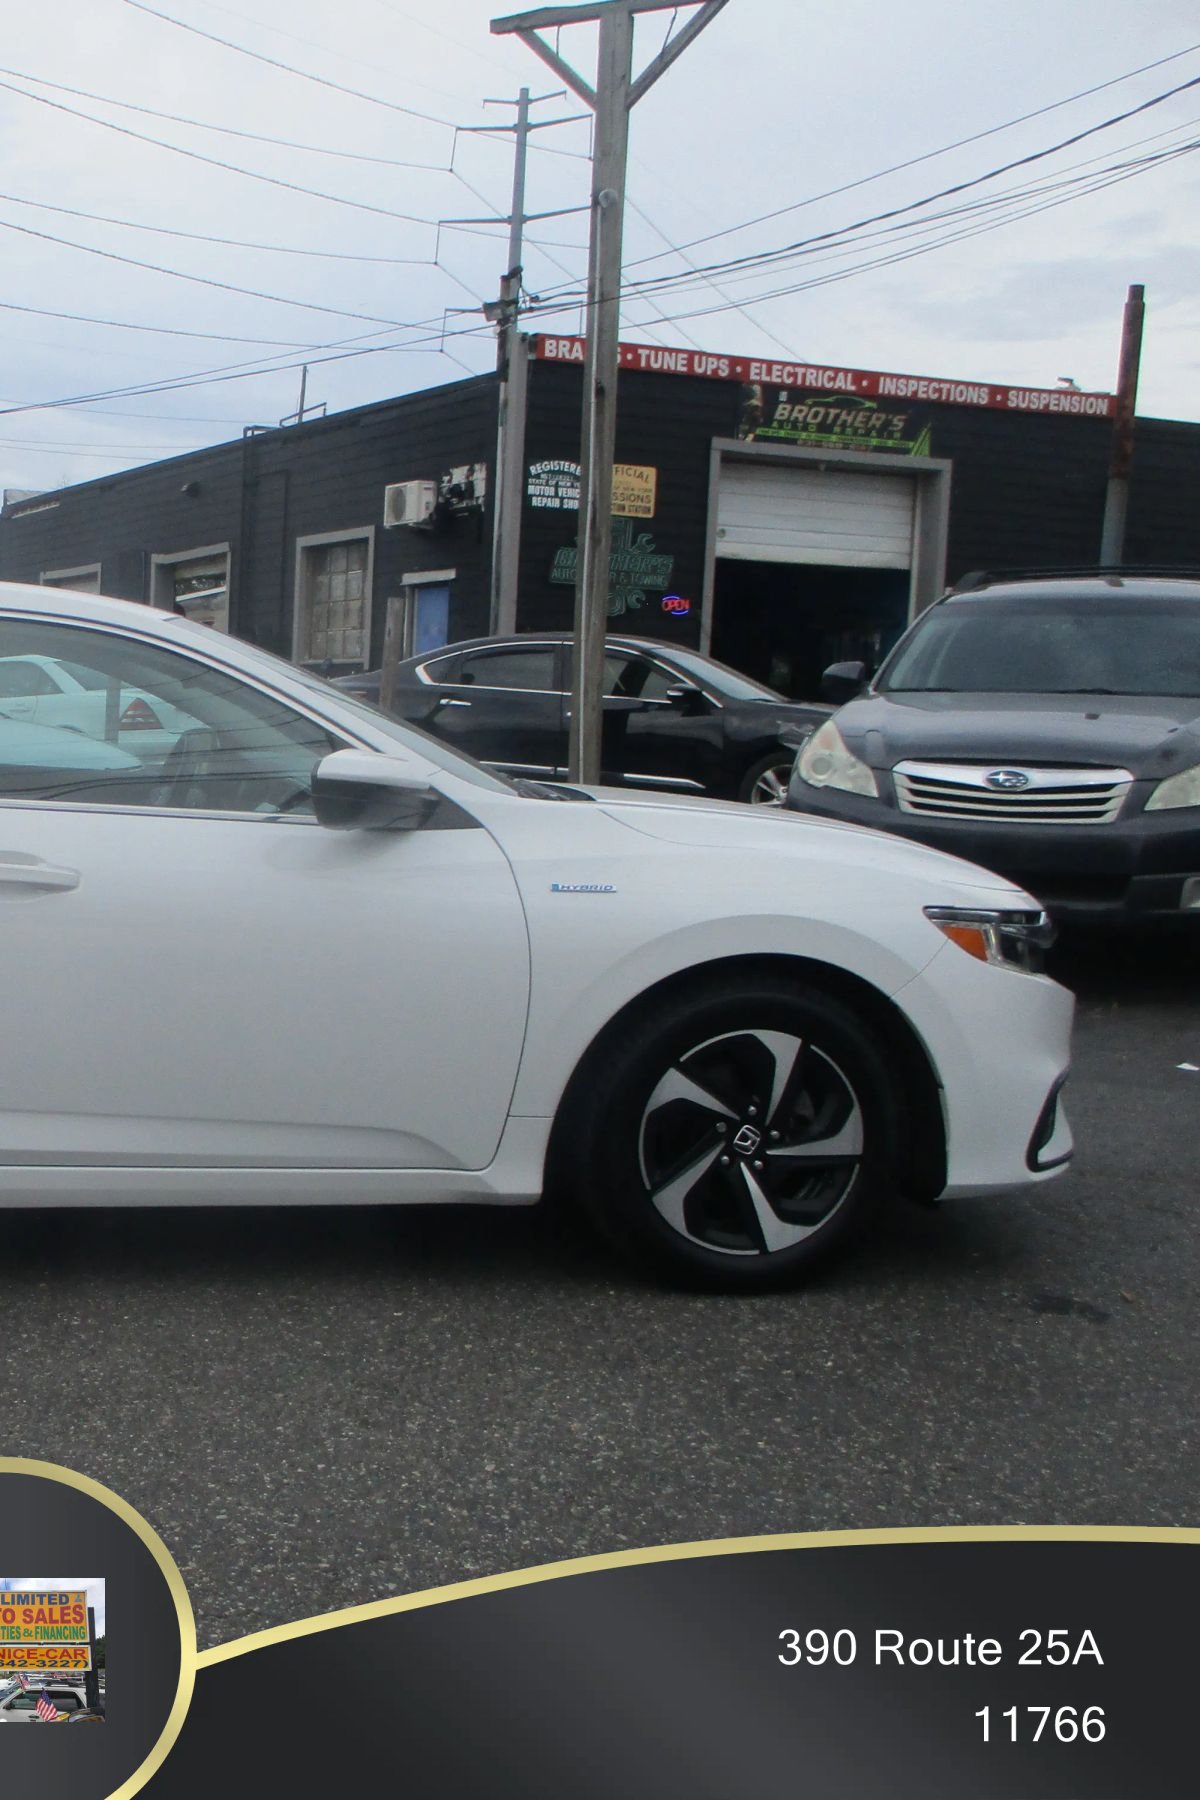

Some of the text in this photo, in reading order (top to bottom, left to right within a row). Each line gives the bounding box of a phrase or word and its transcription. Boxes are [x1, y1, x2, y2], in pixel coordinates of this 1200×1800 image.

[544, 339, 1109, 416] BRA TUNE UPS ELECTRICAL INSPECTIONS SUSPENSION
[773, 403, 907, 430] BROTHER'S
[771, 421, 817, 432] AUTO
[529, 460, 581, 476] REGISTERE
[615, 464, 649, 483] FICIAL
[527, 485, 581, 498] MOTOR VEHIC
[613, 491, 651, 505] SSIONS
[531, 496, 579, 510] REPAIR SHO
[662, 599, 690, 611] OPEN
